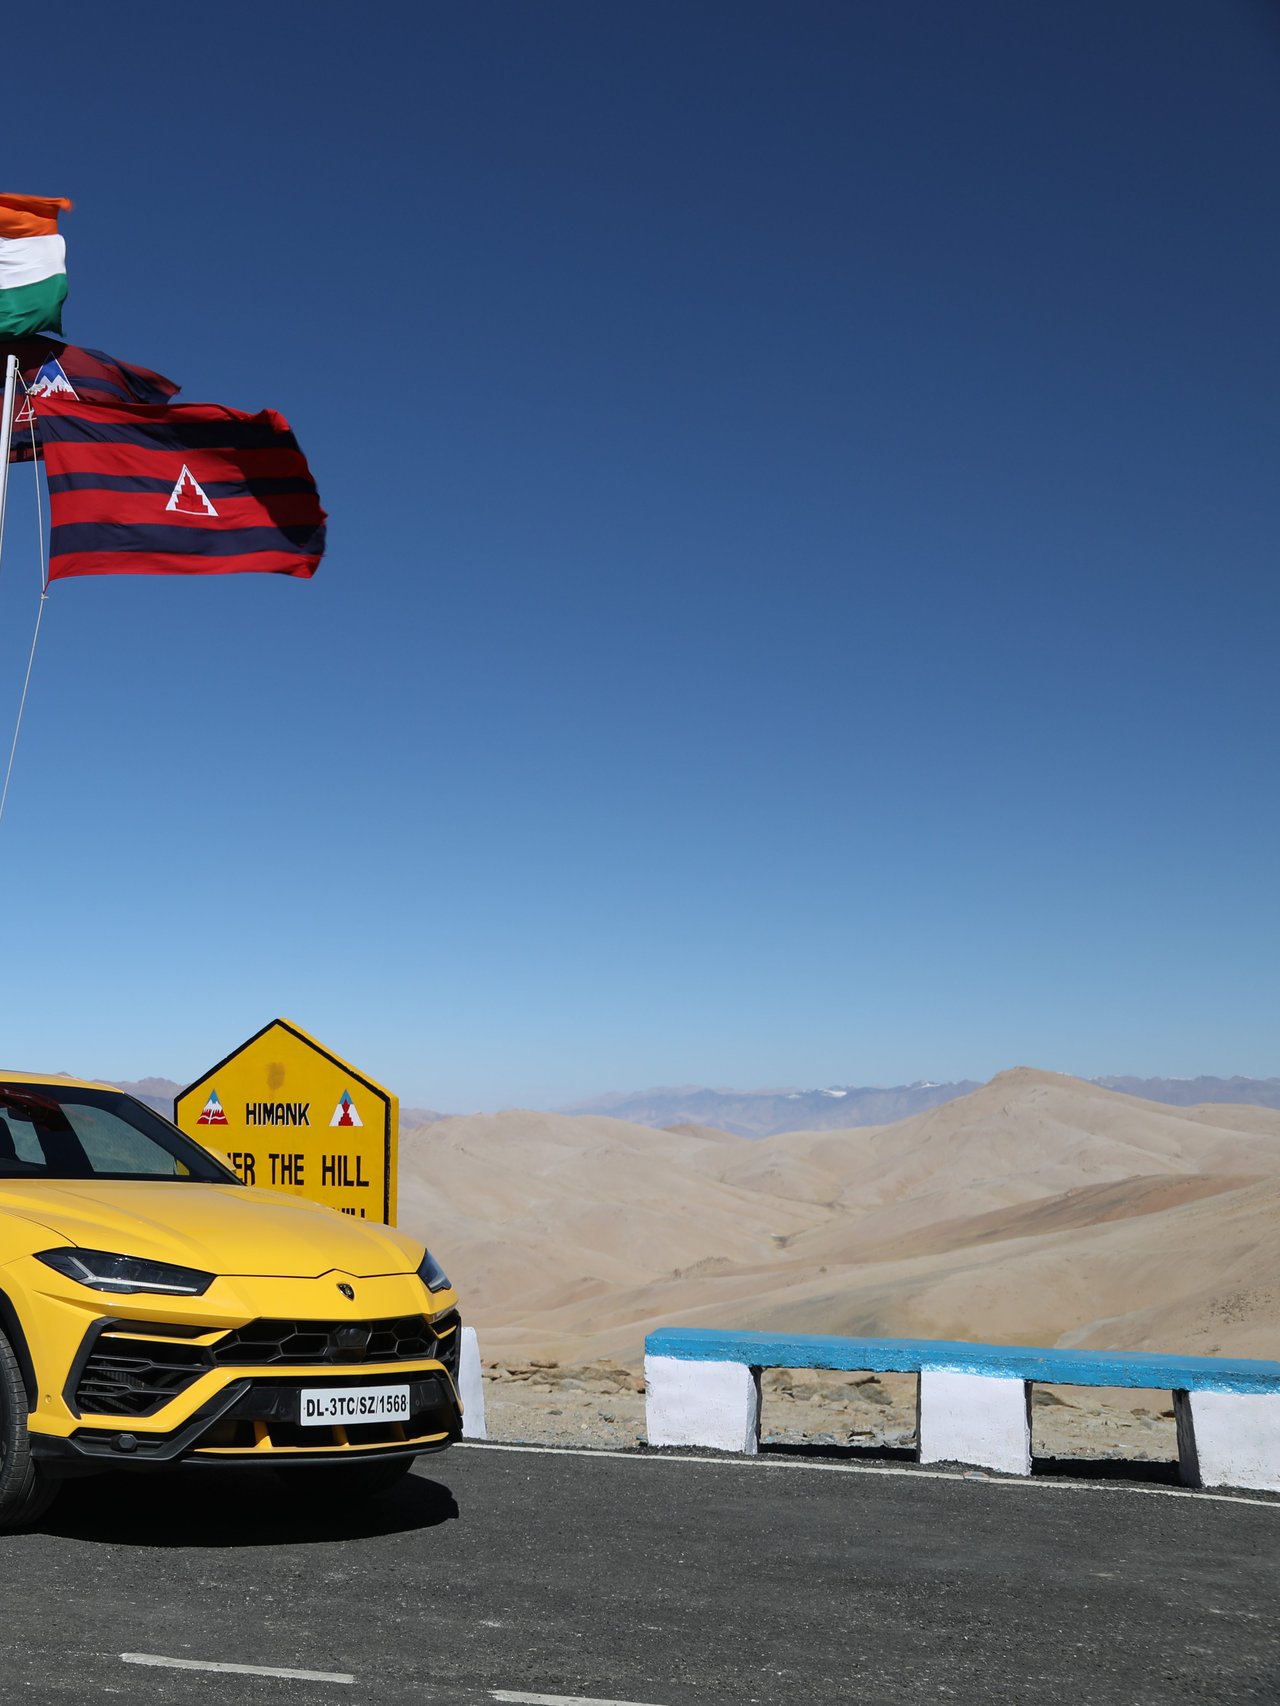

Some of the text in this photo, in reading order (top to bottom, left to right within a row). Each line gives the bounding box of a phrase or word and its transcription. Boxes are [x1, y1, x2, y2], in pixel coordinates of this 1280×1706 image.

[245, 1102, 311, 1127] HIMANK
[227, 1152, 370, 1187] ER THE HILL
[306, 1394, 407, 1417] DL-3TC/SZ/1568
